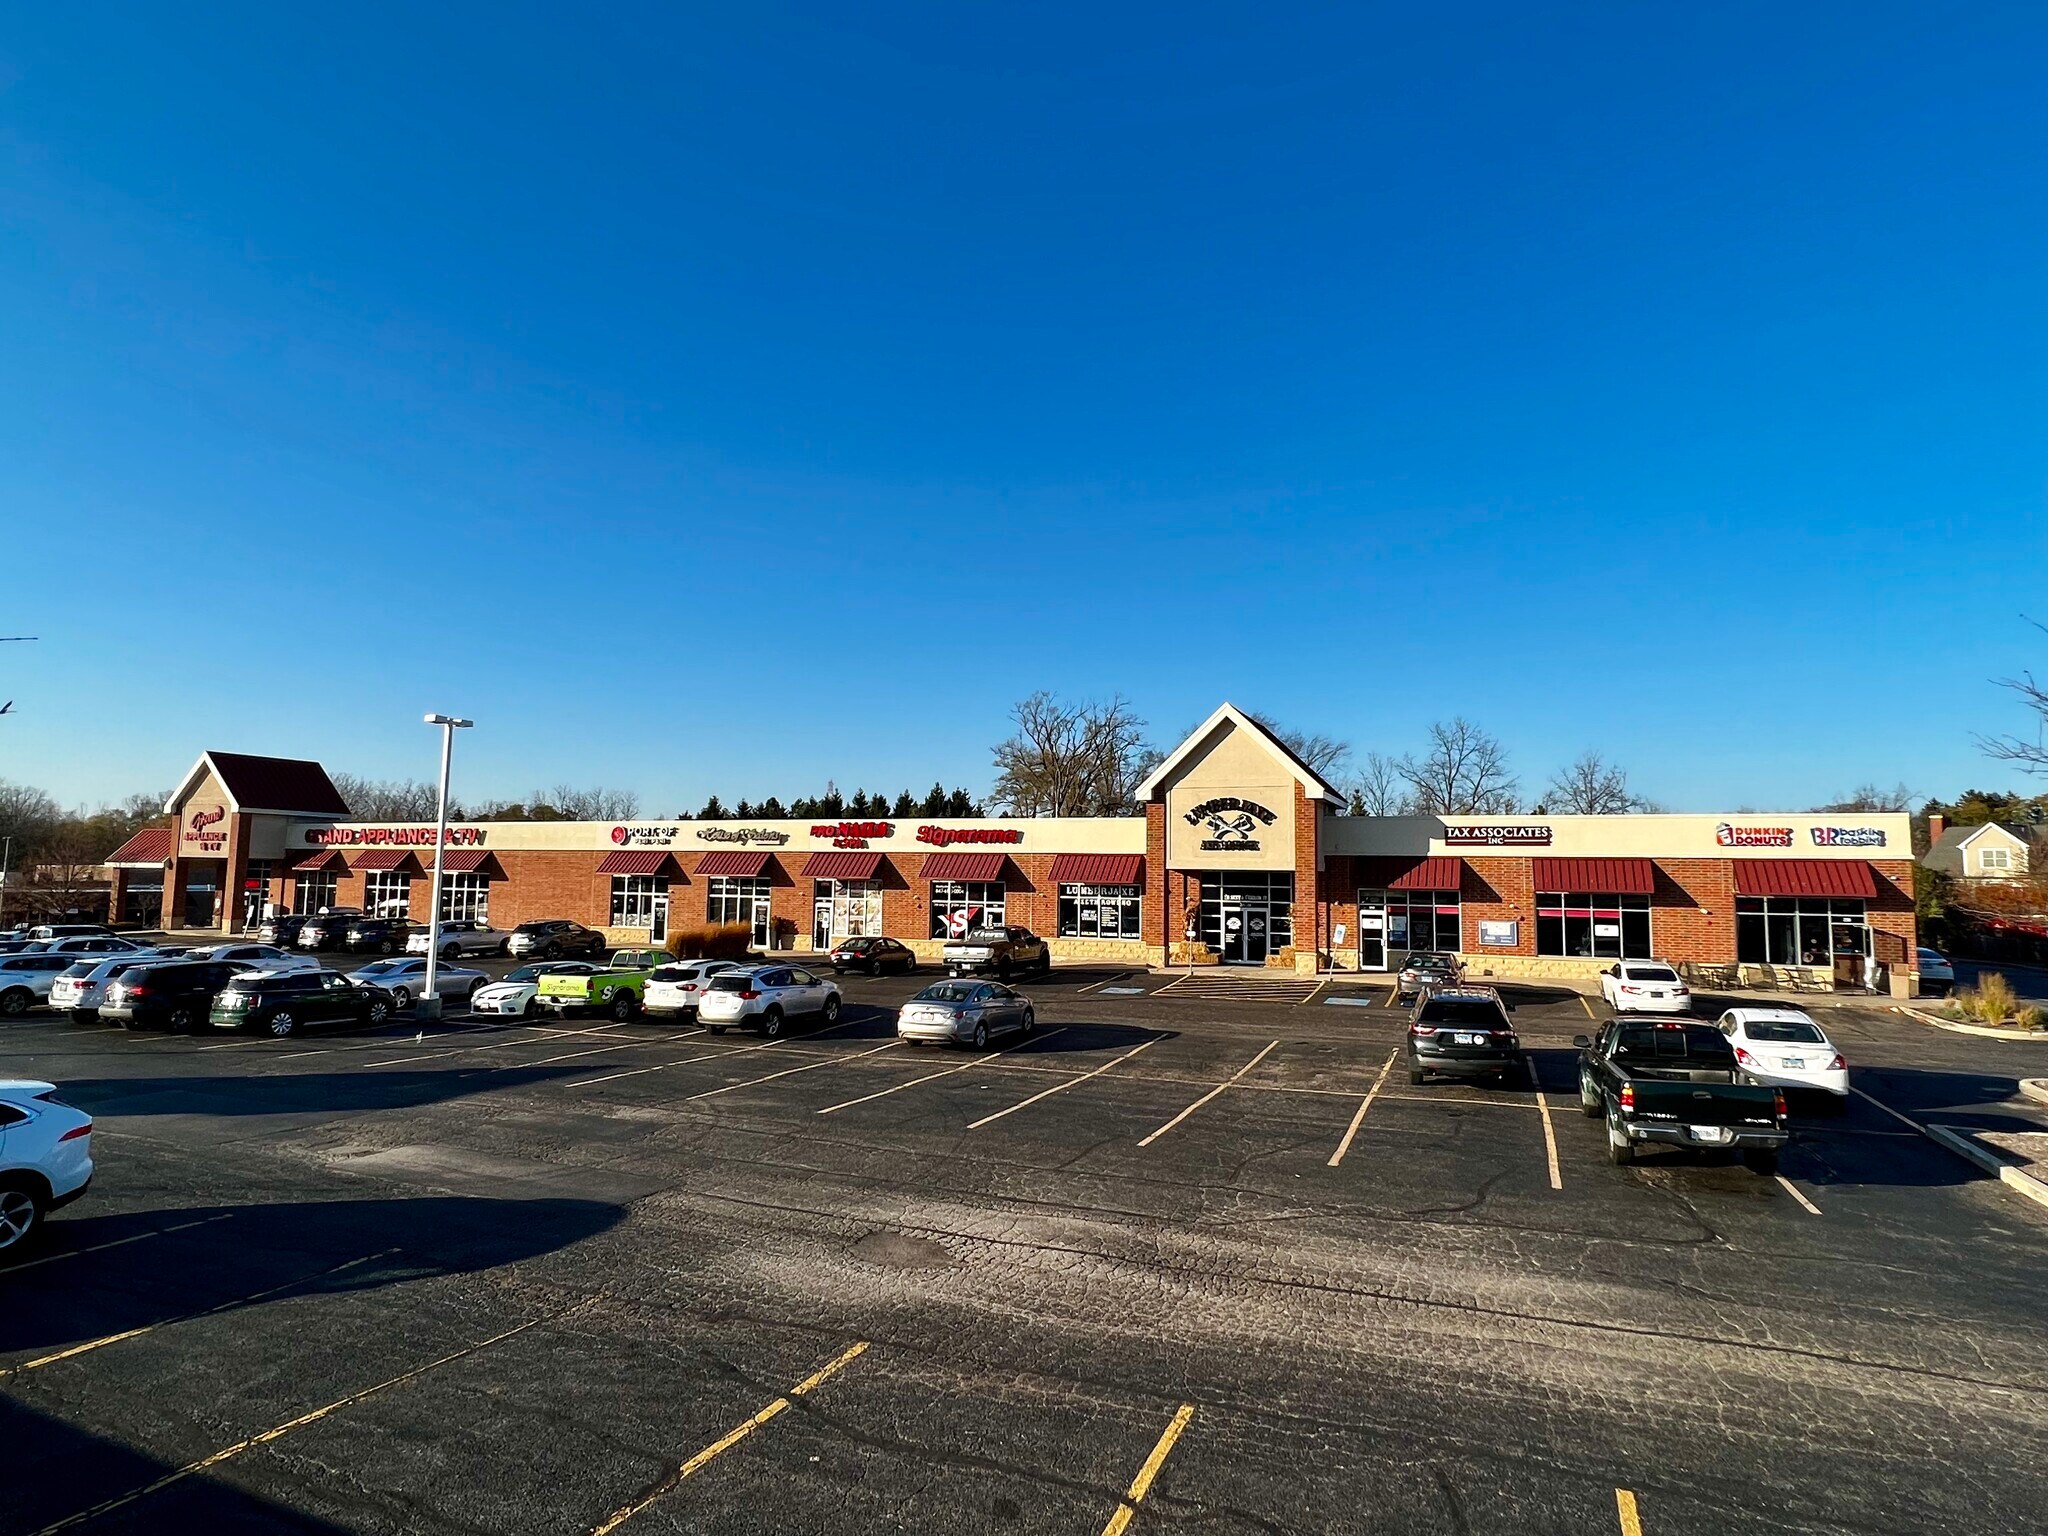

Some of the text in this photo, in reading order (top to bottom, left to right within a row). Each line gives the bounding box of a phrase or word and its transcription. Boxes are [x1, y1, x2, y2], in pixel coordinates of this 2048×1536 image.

[811, 823, 888, 838] PRO NAILS
[916, 825, 1017, 845] Signarama
[1446, 828, 1548, 837] TAX ASSOCIATES
[1839, 828, 1881, 836] baskin
[358, 829, 438, 843] APPLIANCE
[459, 829, 477, 844] TV
[1735, 837, 1787, 845] DONUTS
[546, 984, 580, 992] Signarama
